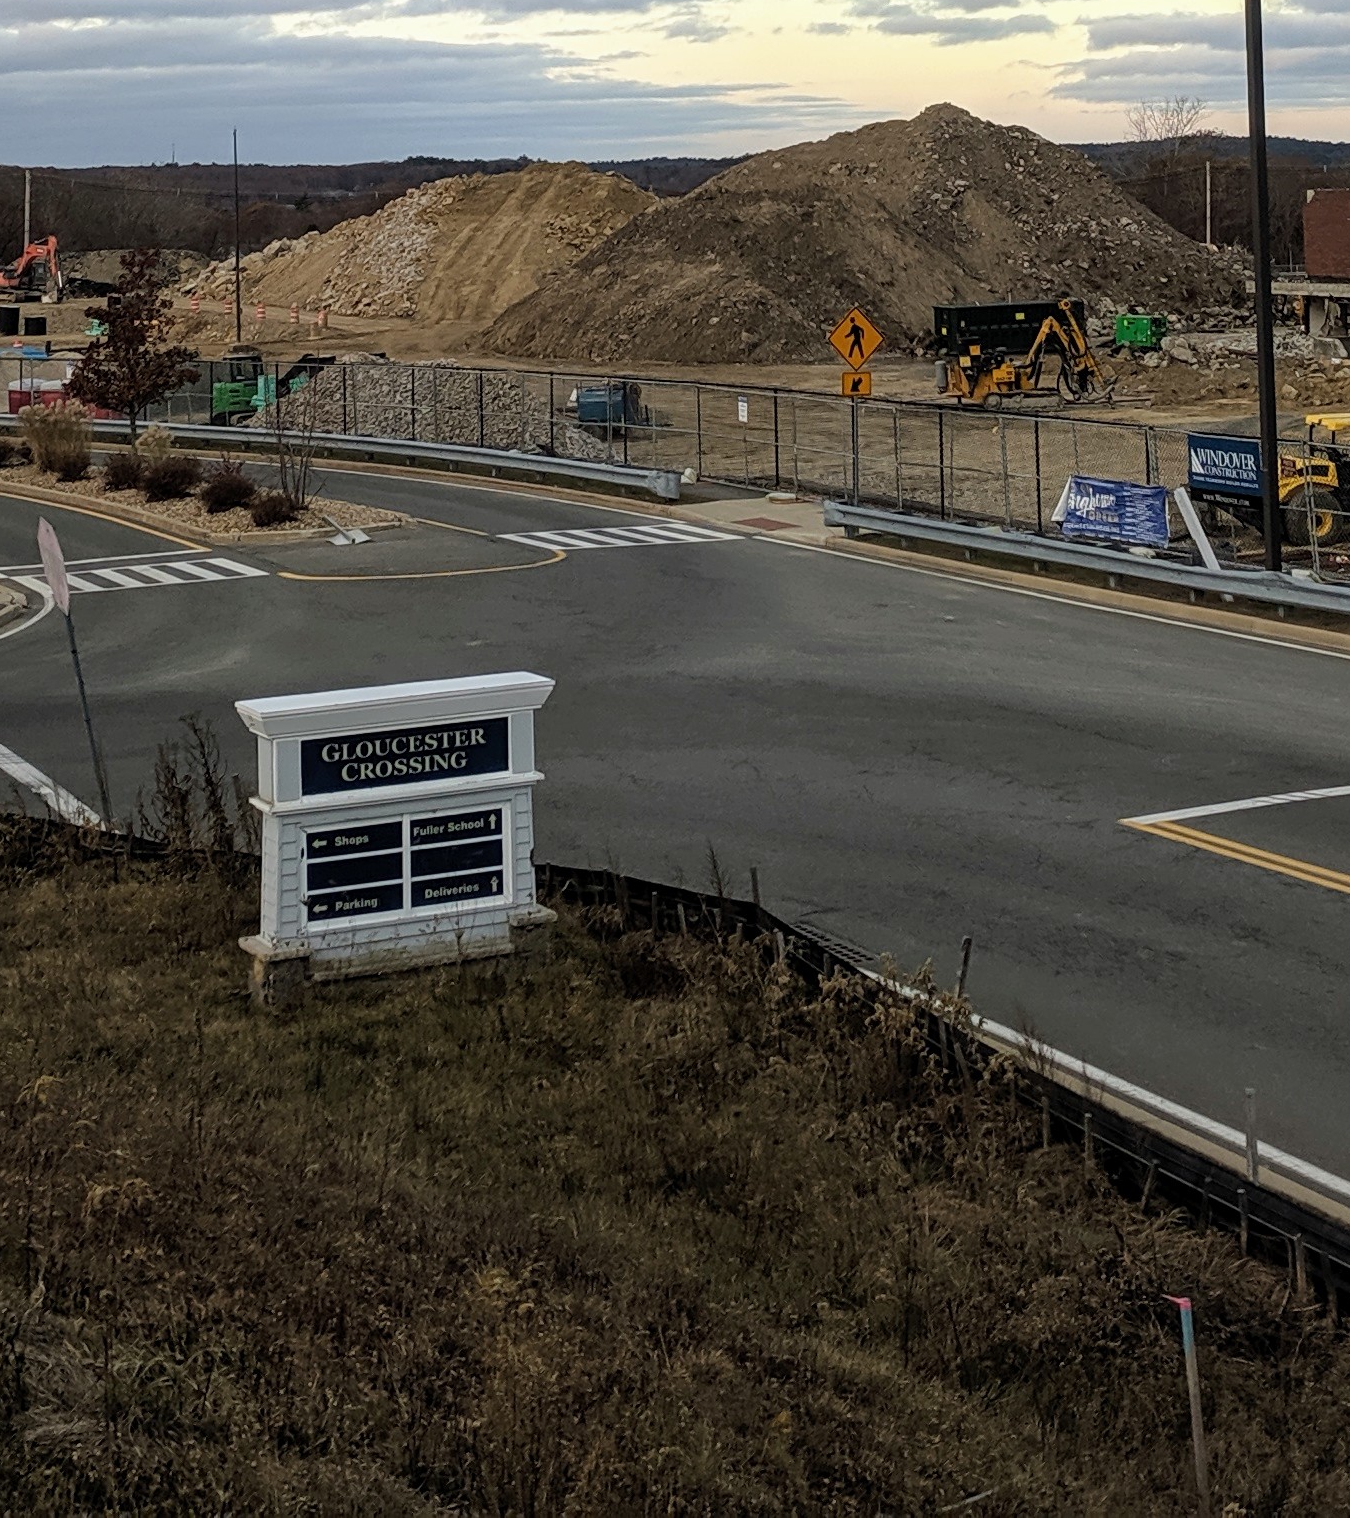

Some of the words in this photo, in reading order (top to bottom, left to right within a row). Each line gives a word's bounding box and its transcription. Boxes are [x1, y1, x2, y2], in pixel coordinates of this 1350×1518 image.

[1196, 447, 1257, 471] WINDOVER
[1203, 465, 1257, 481] CONSTRUCTION
[320, 727, 487, 763] GLOUCESTER
[341, 751, 468, 782] CROSSING
[413, 824, 445, 838] Fuller
[447, 818, 485, 833] School
[334, 834, 370, 848] Shops
[424, 883, 480, 900] Deliveries
[335, 897, 378, 913] Parking
